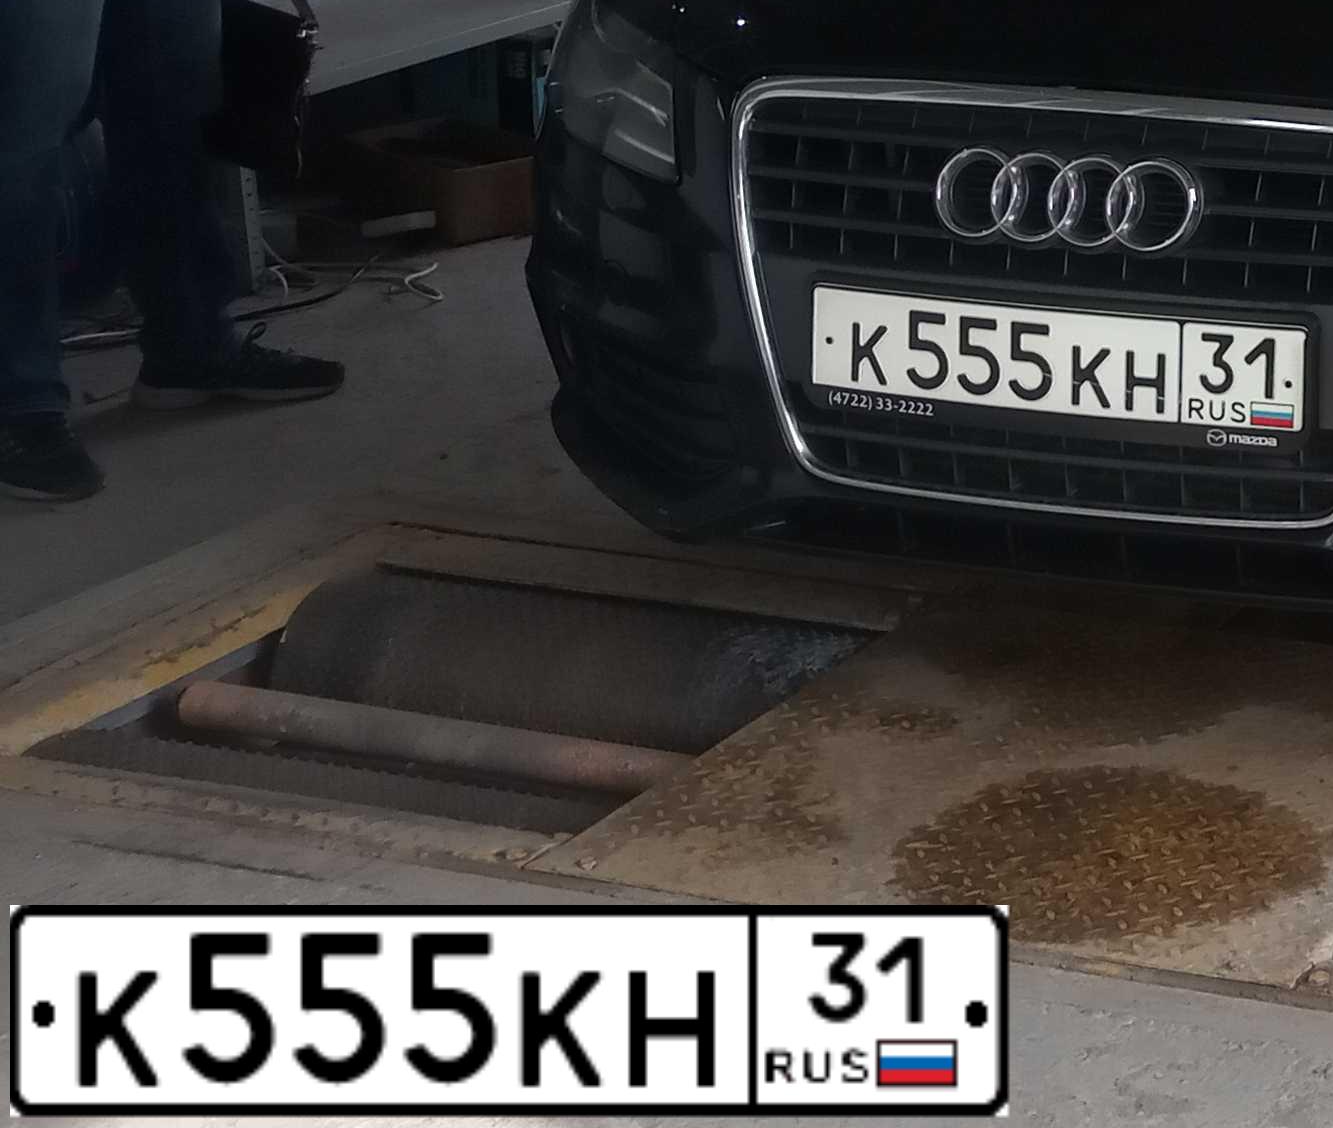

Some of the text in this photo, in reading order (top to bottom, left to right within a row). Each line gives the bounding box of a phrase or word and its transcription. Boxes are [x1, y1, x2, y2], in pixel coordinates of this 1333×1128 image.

[1199, 332, 1275, 399] 31
[828, 390, 934, 416] (4722) 33-2222
[1188, 398, 1246, 423] RUS
